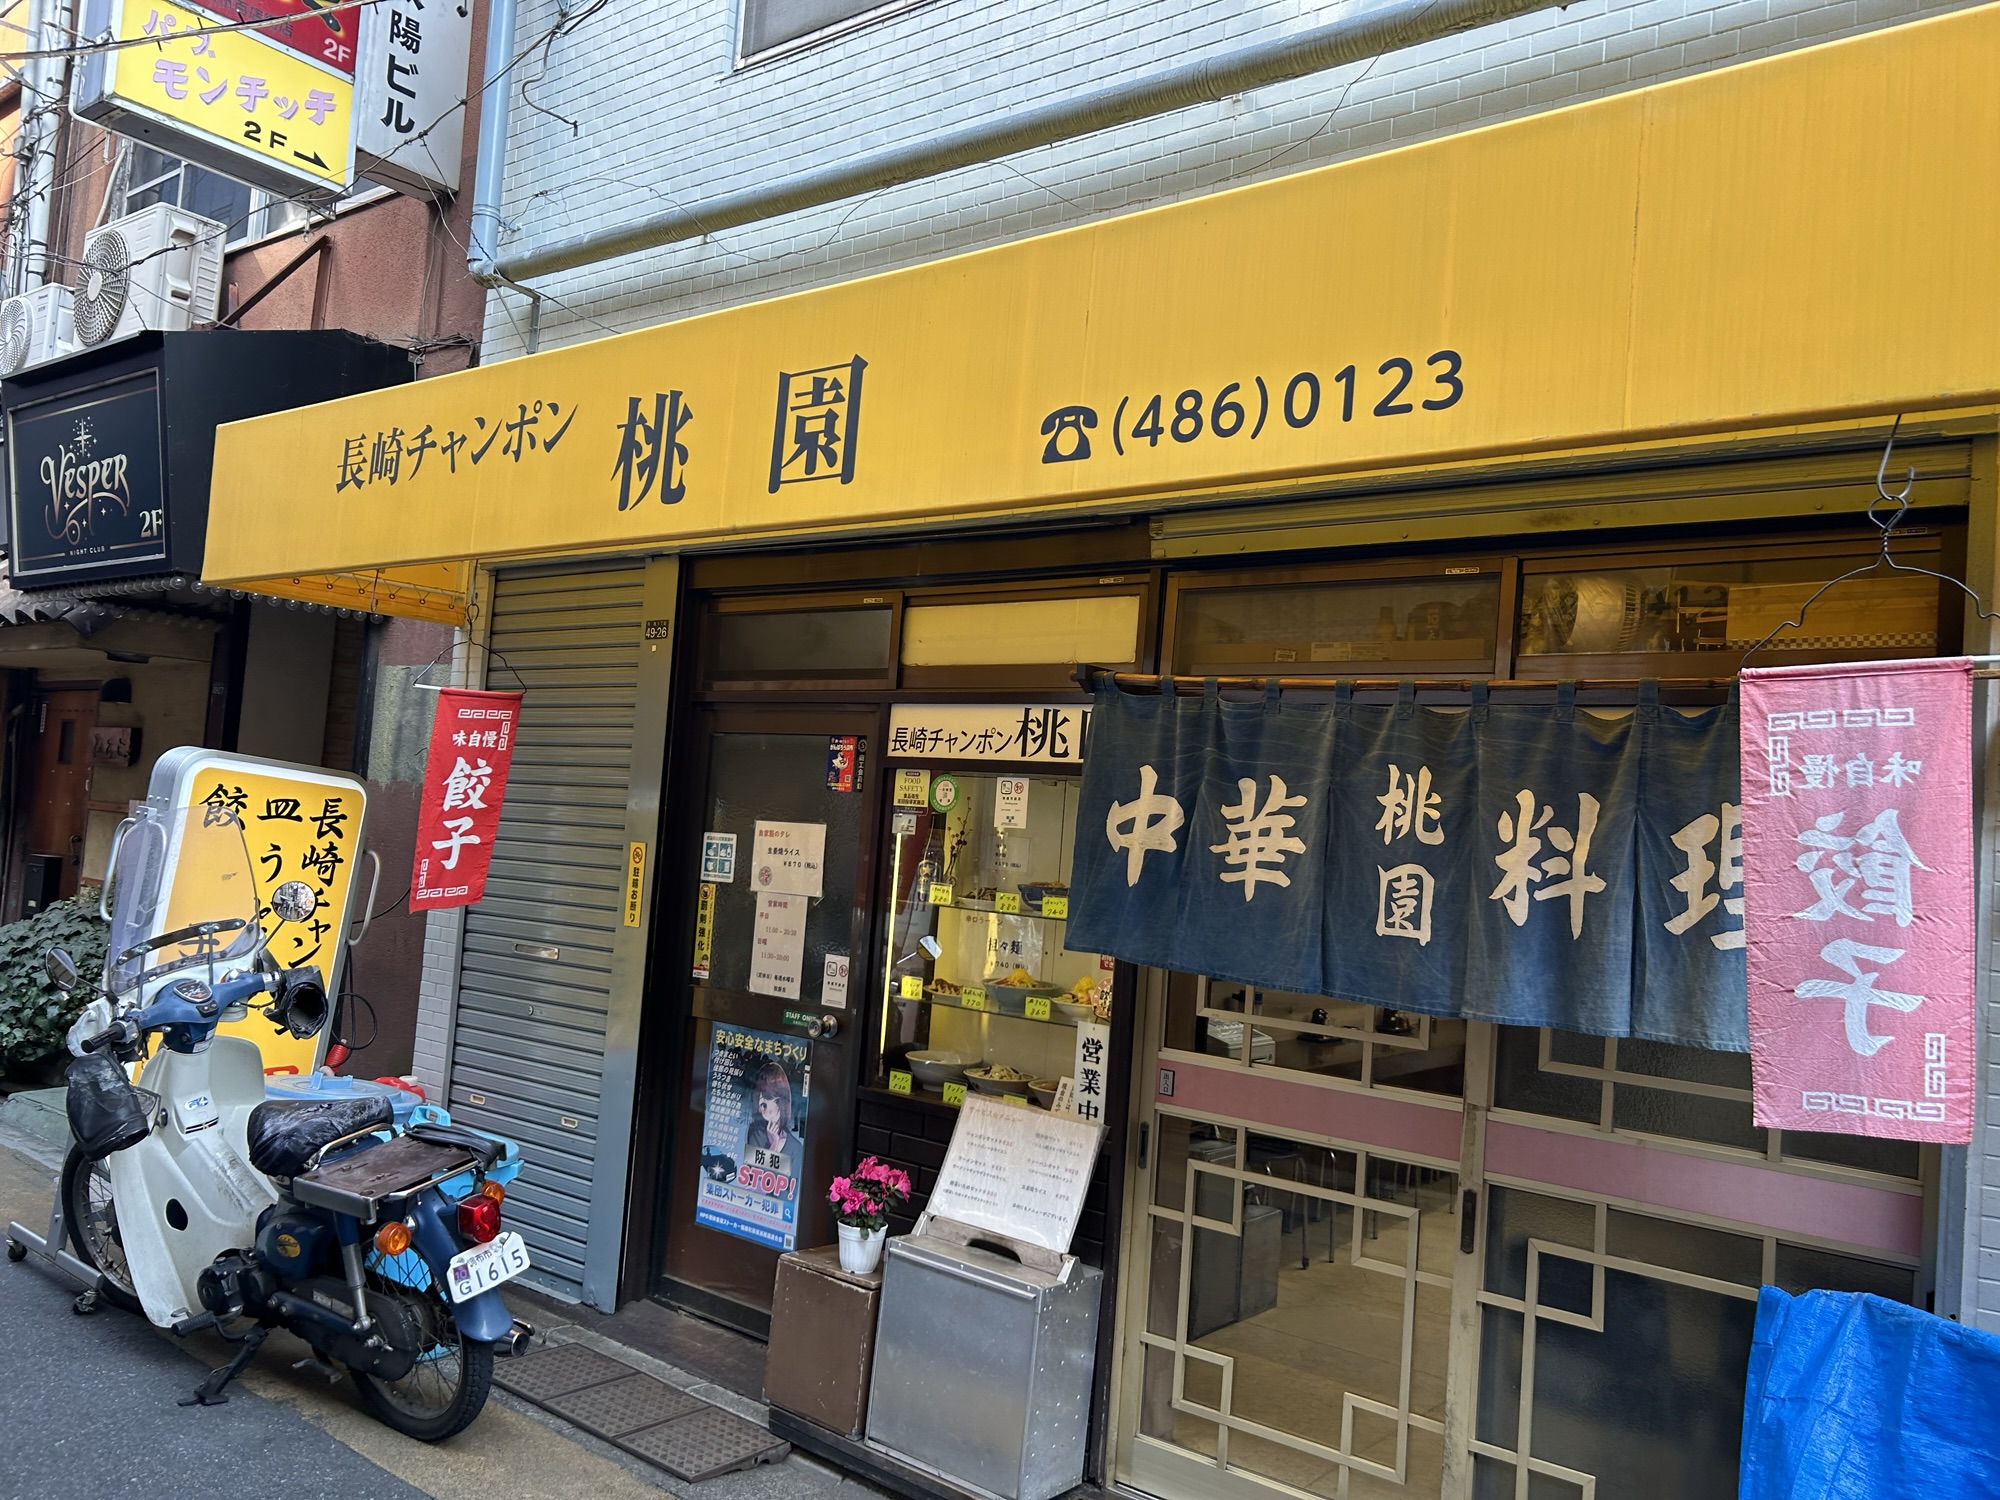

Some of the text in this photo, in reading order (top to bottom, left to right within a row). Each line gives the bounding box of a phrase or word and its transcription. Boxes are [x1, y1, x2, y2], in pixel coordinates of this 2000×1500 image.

[322, 37, 351, 63] 2F
[380, 0, 424, 134] 陽ビル
[152, 59, 337, 126] モンチッチ
[1112, 349, 1465, 457] (486)0123
[336, 399, 578, 494] 長崎チャンポン
[139, 508, 163, 538] 2F
[89, 545, 105, 554] CLUB
[645, 626, 667, 639] 49-26
[452, 730, 499, 750] 味自慢
[891, 727, 1013, 755] 長崎チャンポン
[899, 785, 925, 793] SAFETY
[903, 777, 922, 785] FOOD
[431, 756, 494, 871] 餃子
[1374, 763, 1445, 947] 桃園
[785, 1011, 801, 1020] STAFF
[715, 1029, 808, 1062] 安心安全なまちづくり
[1077, 1036, 1104, 1121] 営業中
[726, 1151, 738, 1159] etc
[754, 1148, 781, 1170] 防犯
[705, 1181, 780, 1215] 集団ストーカー犯罪
[737, 1164, 797, 1201] STOP!
[475, 1248, 524, 1289] 1615
